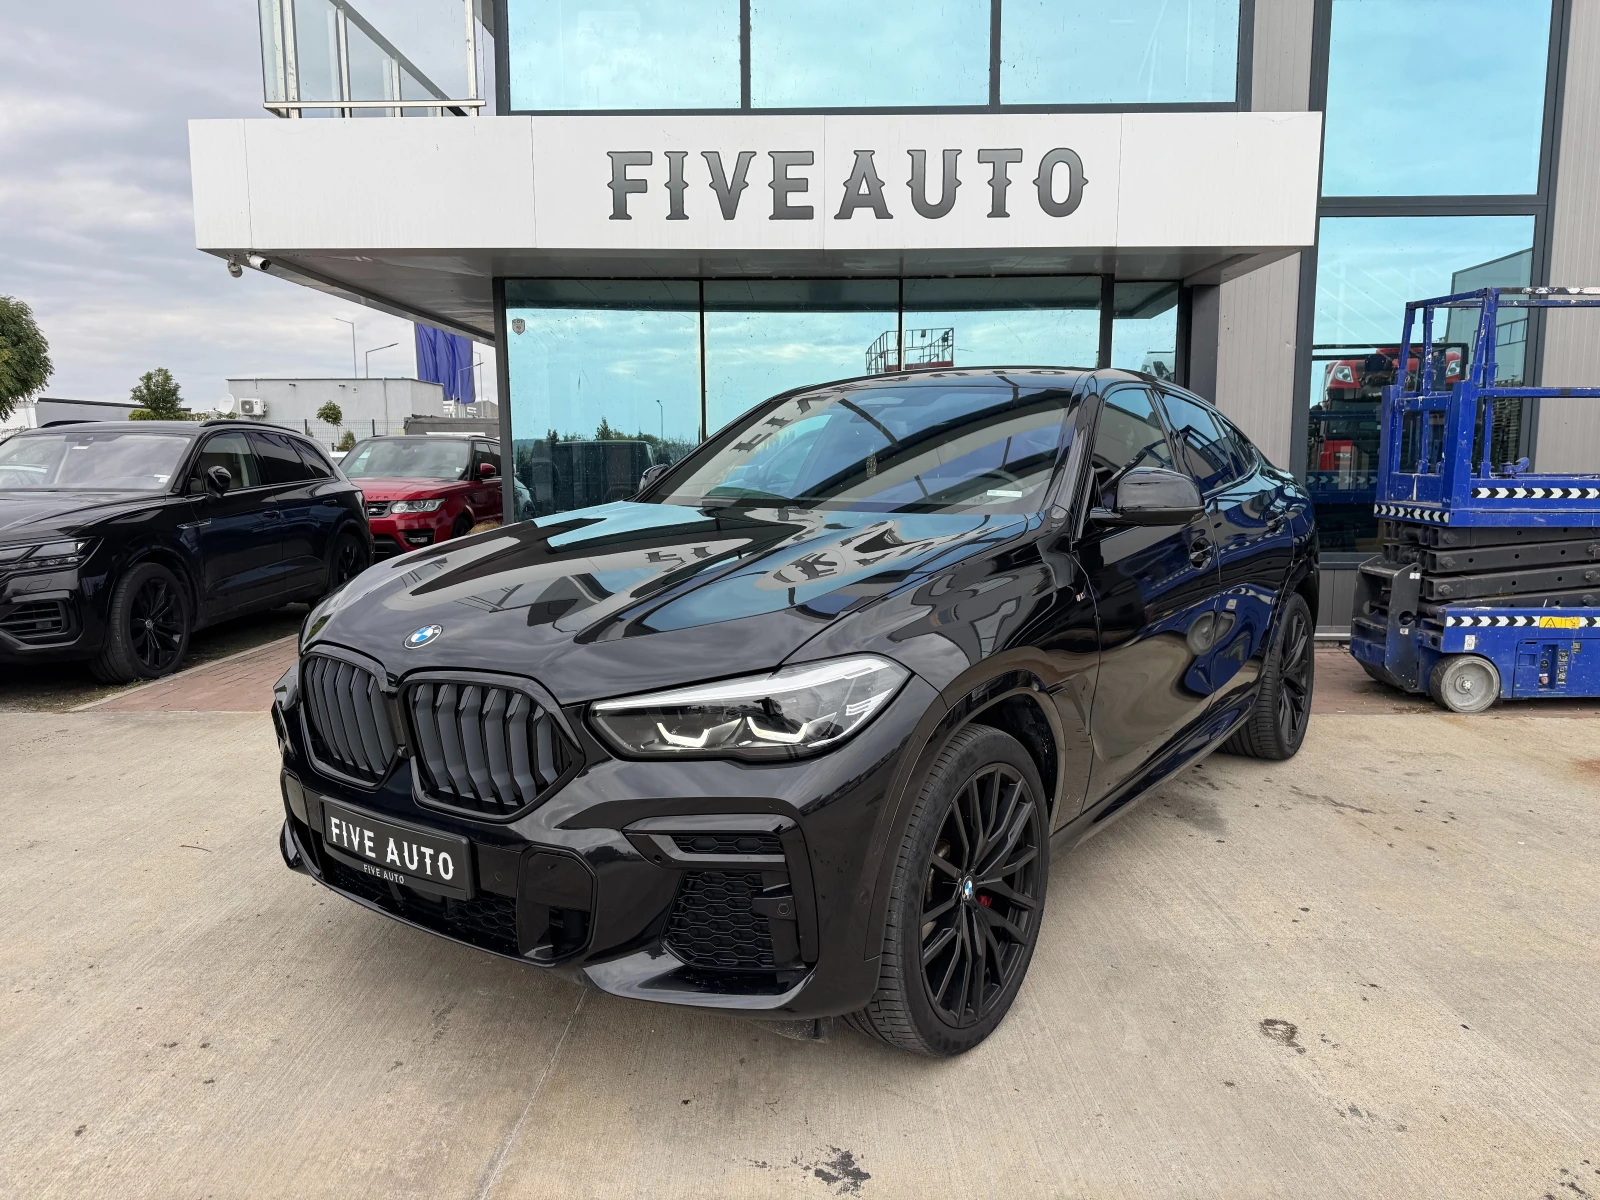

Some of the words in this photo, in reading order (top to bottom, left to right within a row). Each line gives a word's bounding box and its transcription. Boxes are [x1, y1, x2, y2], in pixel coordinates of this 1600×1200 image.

[606, 150, 814, 220] FIVE
[833, 147, 1089, 220] AUTO
[330, 816, 376, 858] FIVE
[386, 837, 455, 881] AUTO
[363, 863, 381, 878] FIVE
[383, 870, 405, 885] AUTO
